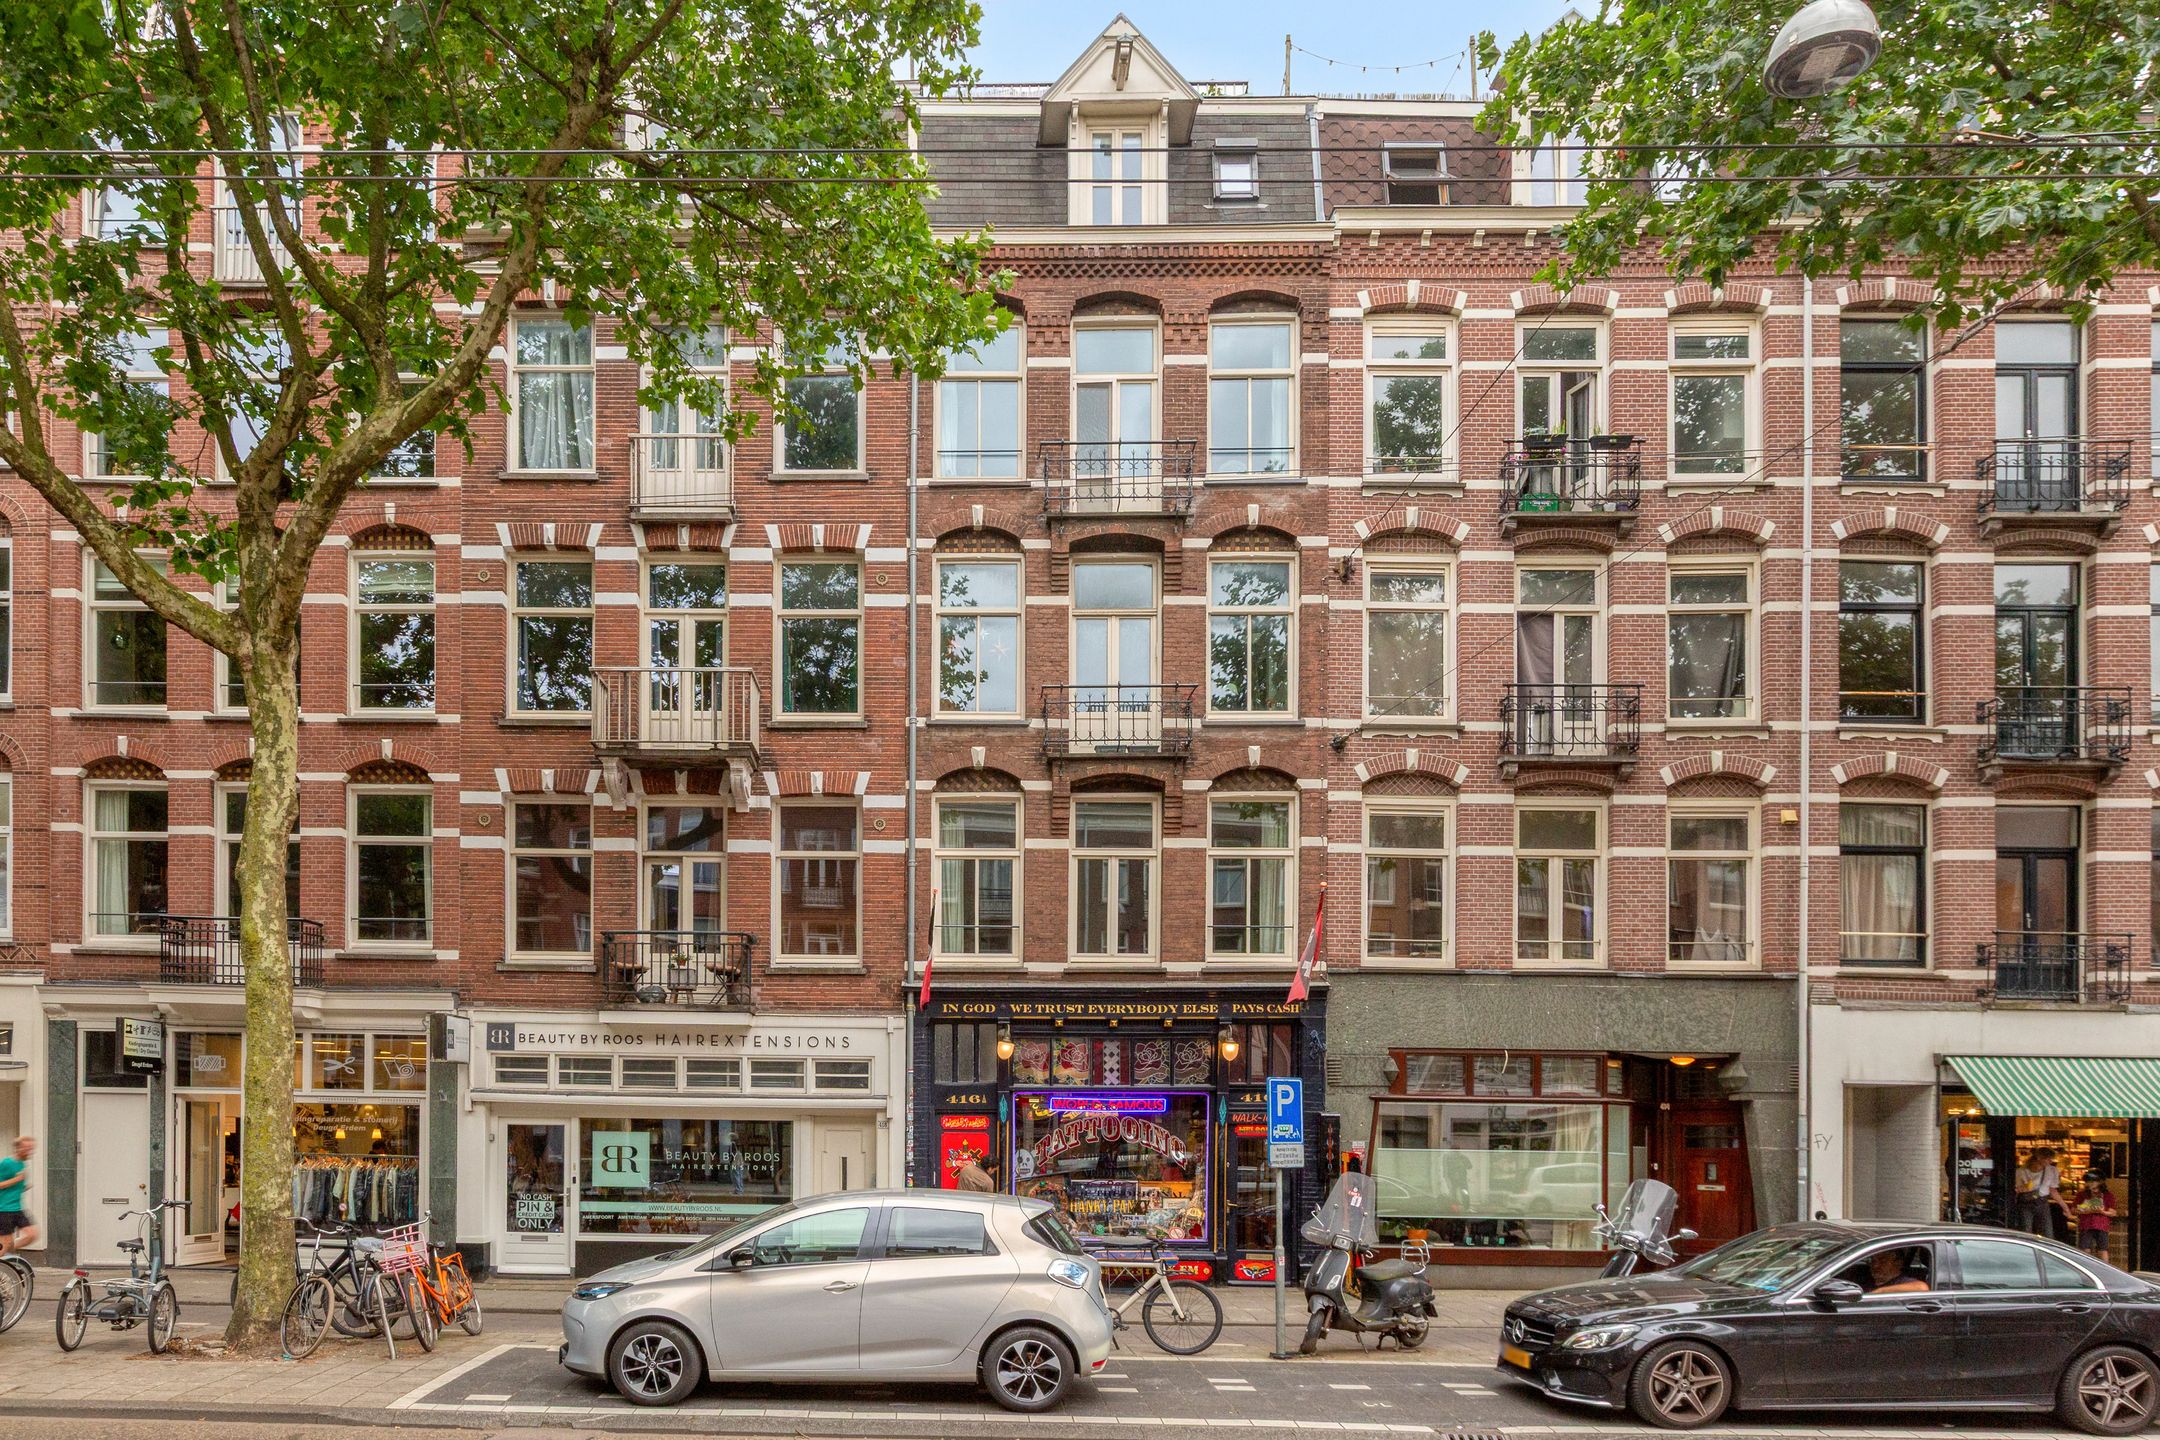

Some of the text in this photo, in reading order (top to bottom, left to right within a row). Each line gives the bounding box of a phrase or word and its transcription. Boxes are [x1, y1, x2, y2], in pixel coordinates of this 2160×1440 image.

[942, 1003, 1300, 1013] IN GOD WE TRUST EVERYBODY ELSE PAYS CASH
[518, 1033, 850, 1049] BEAUTY BY ROOS HAIREXTENSIONS
[1277, 1084, 1295, 1117] P
[1232, 1113, 1268, 1122] WALK-I
[1034, 1116, 1188, 1171] TATTOOING
[666, 1151, 781, 1162] BEAUTY BY ROOS
[671, 1163, 775, 1172] HAIREXTENSIONS
[518, 1202, 553, 1212] PIN &
[648, 1205, 722, 1213] WWW.BEAUTYBYROOS.NL
[1069, 1199, 1107, 1213] HANKY
[518, 1218, 553, 1229] ONLY
